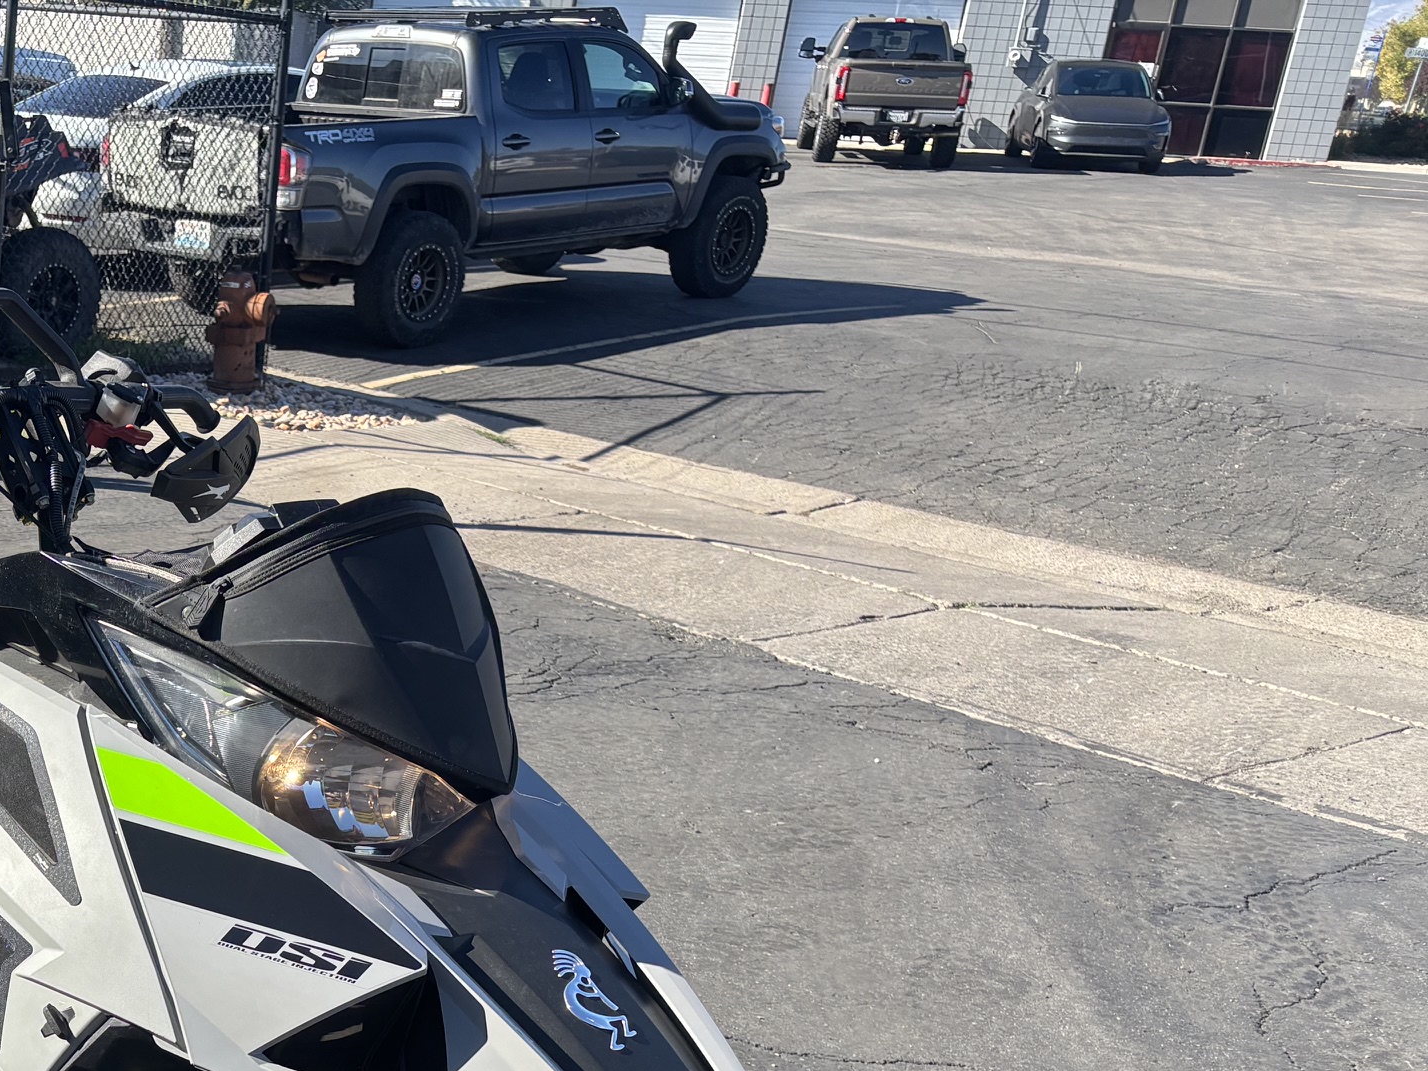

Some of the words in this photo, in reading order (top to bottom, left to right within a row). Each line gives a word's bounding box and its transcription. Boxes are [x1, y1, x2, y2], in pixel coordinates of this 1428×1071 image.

[304, 129, 343, 145] TRD
[217, 941, 248, 953] DUAL
[251, 951, 288, 965] STAGE
[291, 962, 357, 984] INJECTION
